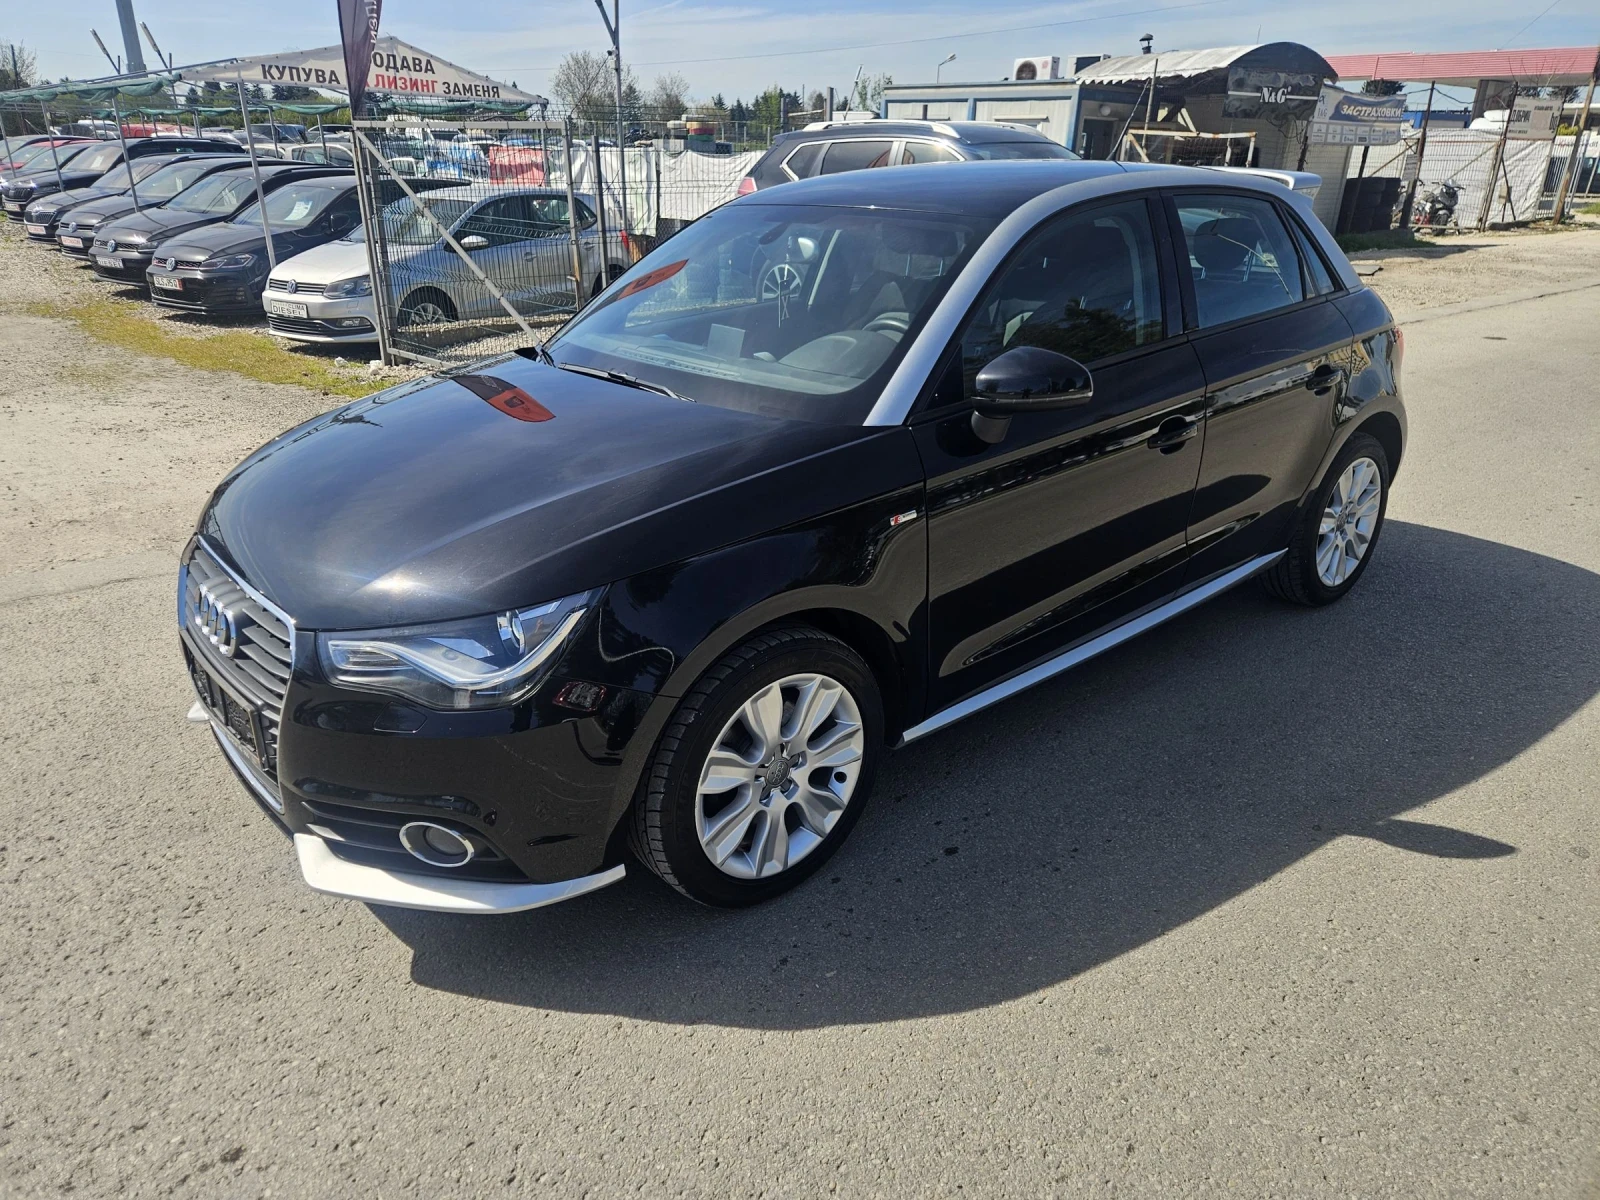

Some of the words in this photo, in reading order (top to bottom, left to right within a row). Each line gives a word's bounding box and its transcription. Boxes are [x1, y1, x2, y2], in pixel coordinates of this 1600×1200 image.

[371, 51, 436, 75] ОДАВА
[260, 63, 341, 85] КУПУВА
[373, 73, 438, 94] ЛИЗИНГ
[442, 81, 501, 99] ЗАМЕНЯ
[1340, 104, 1402, 118] ЗАСТРАХОВКИ
[272, 305, 304, 316] DIESEL
[287, 303, 305, 311] CLIMA
